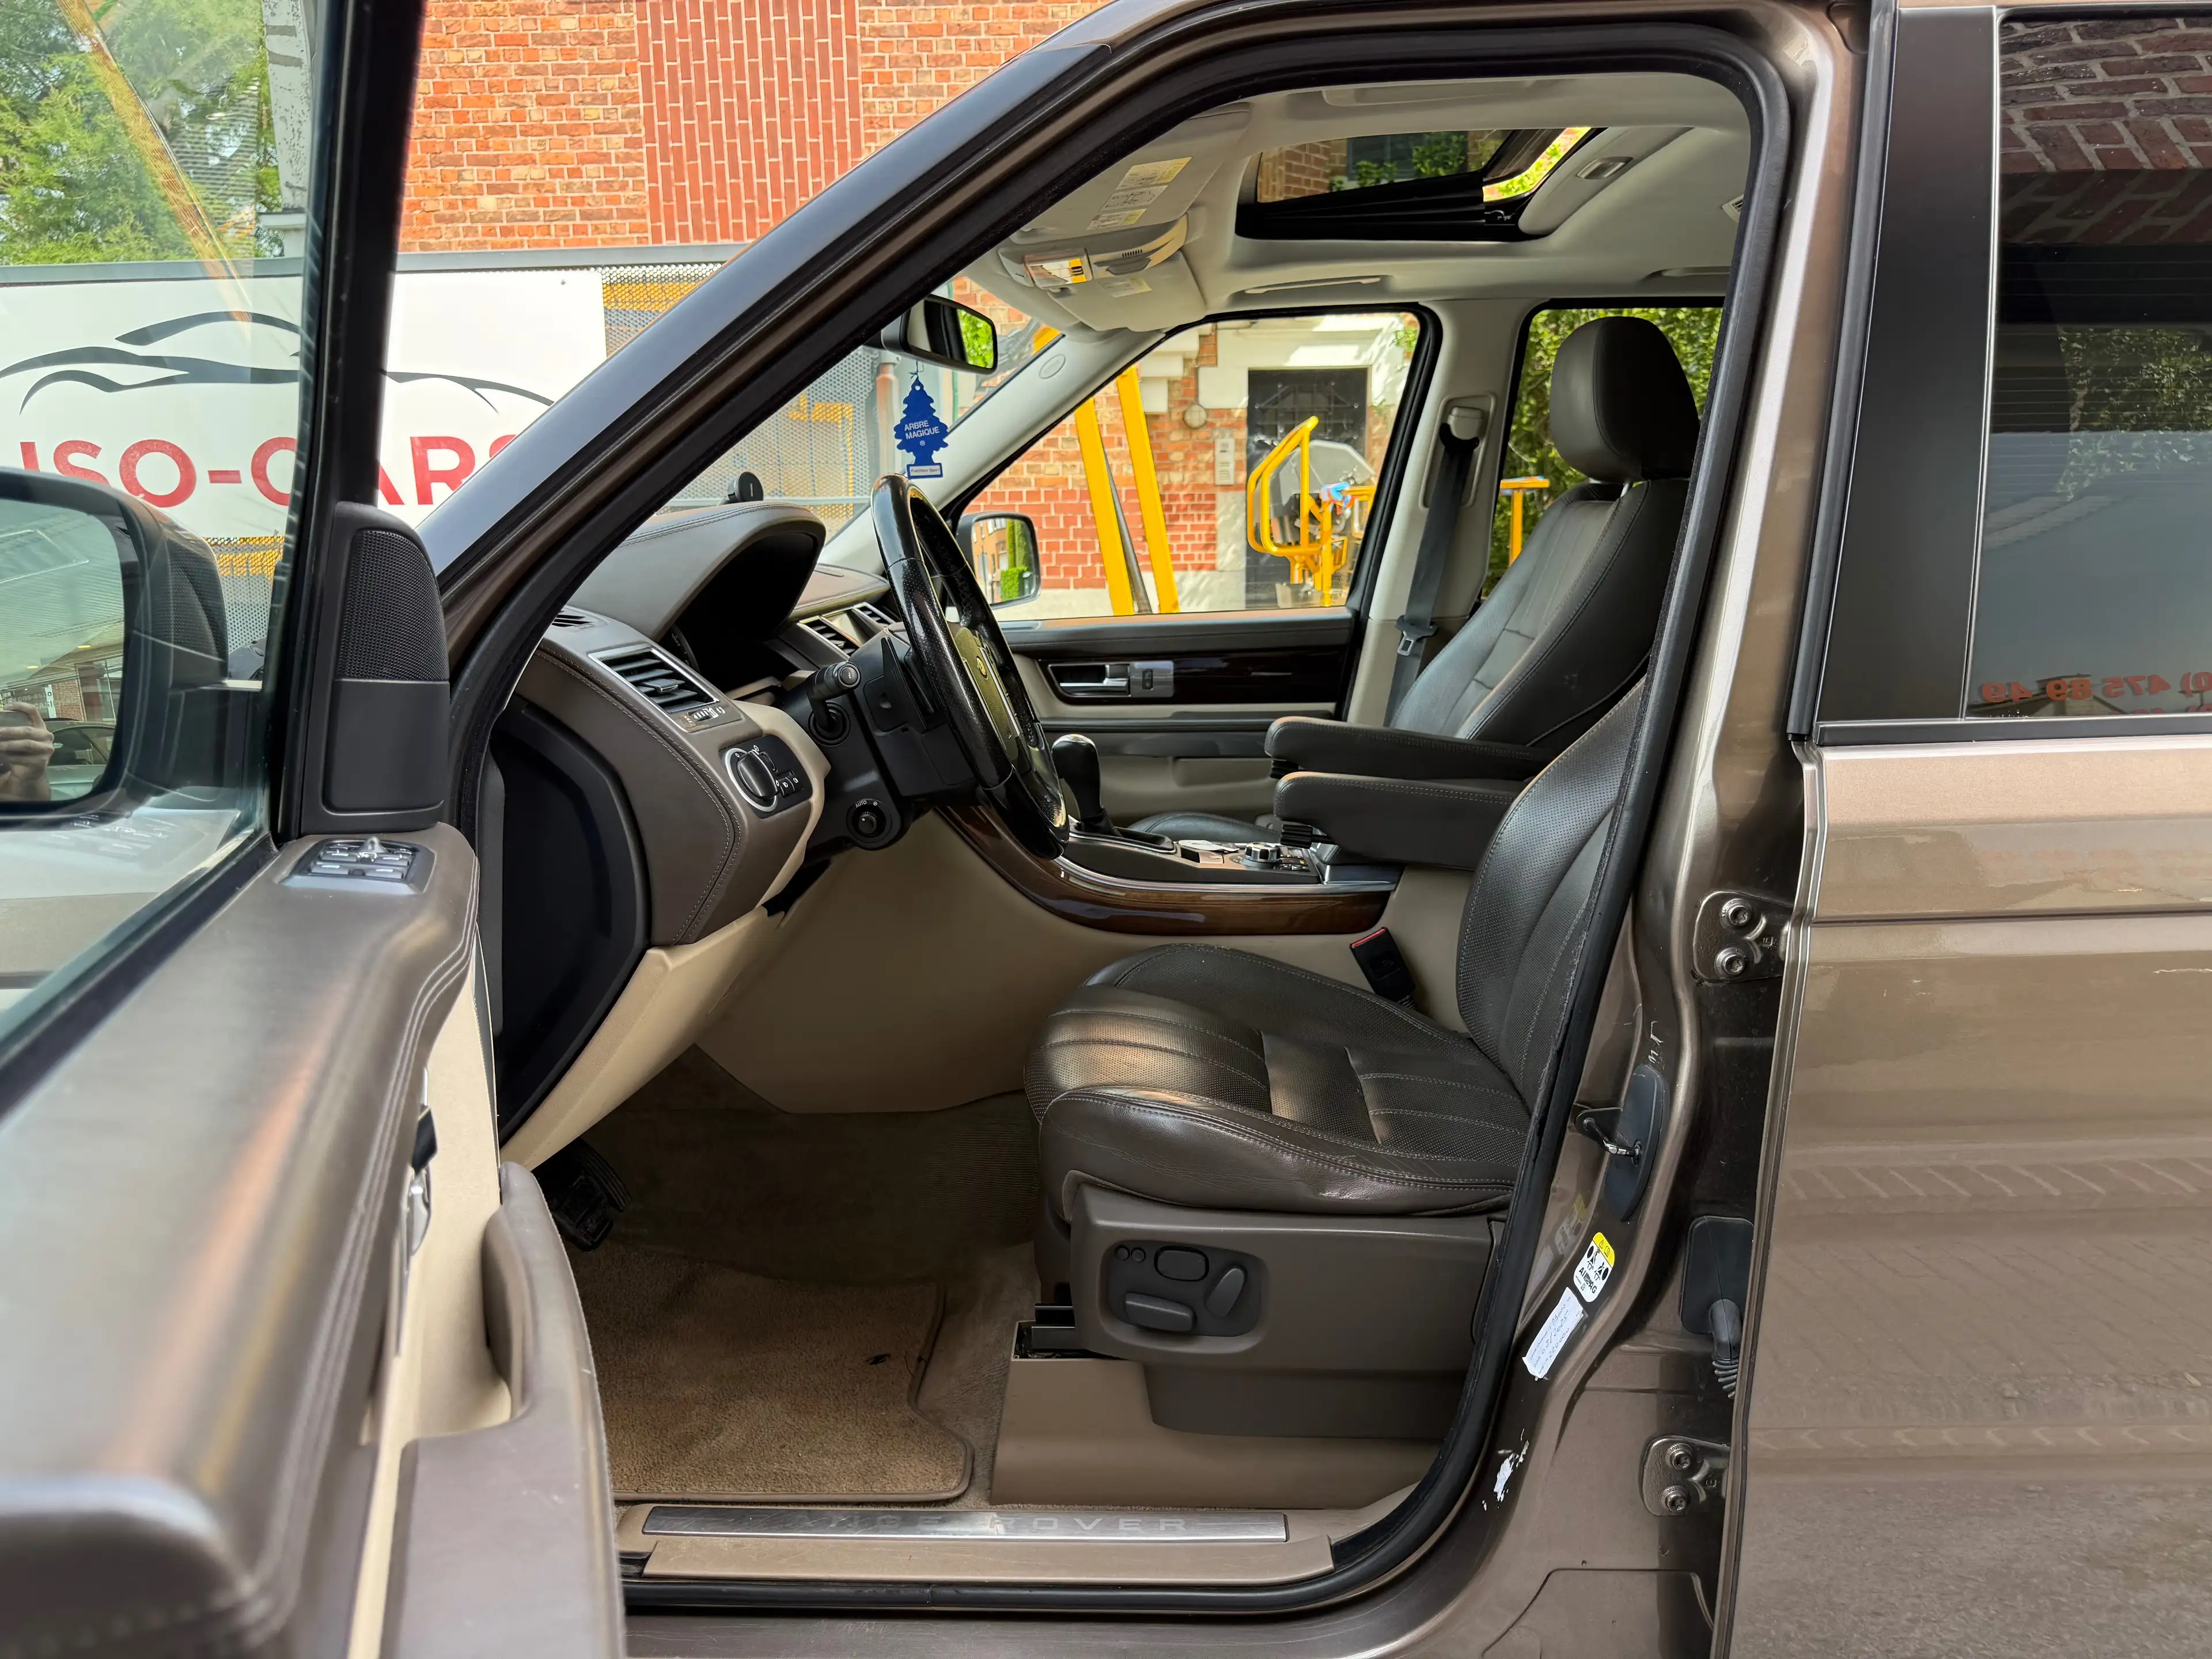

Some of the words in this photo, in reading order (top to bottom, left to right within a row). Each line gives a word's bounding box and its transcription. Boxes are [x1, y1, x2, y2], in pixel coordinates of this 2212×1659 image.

[904, 420, 930, 431] ARBRE
[905, 426, 940, 440] MAGIQUE
[989, 1515, 1187, 1531] ROVER
